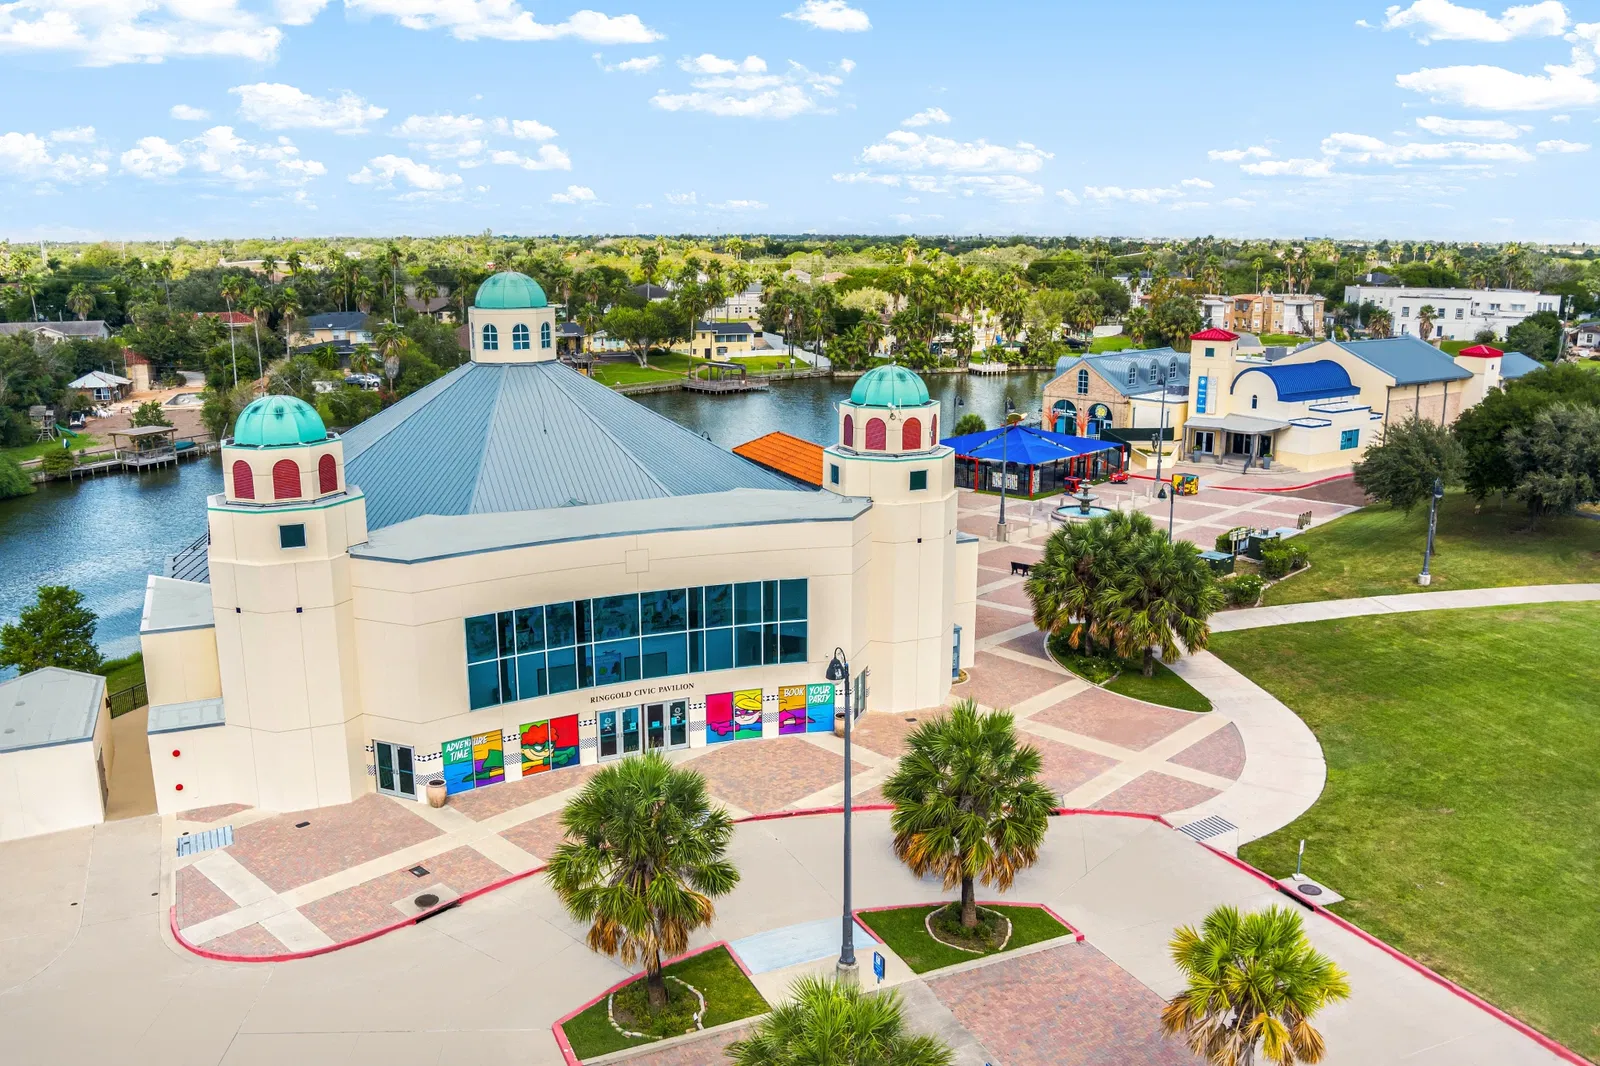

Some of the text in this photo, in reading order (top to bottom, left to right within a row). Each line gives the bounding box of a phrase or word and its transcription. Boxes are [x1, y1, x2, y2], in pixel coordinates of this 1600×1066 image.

[590, 683, 695, 703] RINGGOLD CIVIC PAVILION
[784, 685, 831, 697] BOOK YOUR
[808, 694, 831, 704] PARTY
[450, 747, 470, 762] TIME
